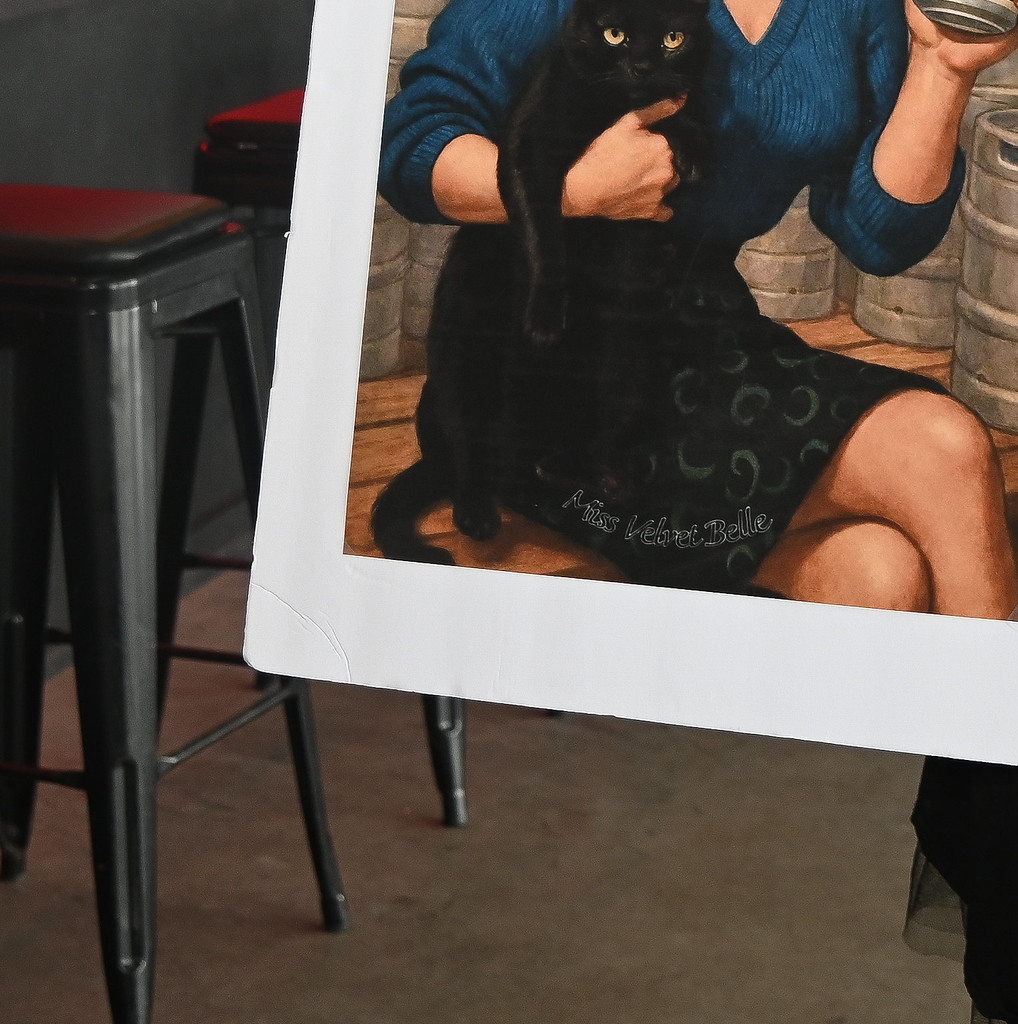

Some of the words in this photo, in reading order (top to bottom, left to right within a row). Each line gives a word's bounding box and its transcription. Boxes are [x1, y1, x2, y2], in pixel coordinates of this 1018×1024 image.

[562, 489, 620, 533] Miss
[624, 515, 704, 549] Velvet
[704, 506, 774, 547] Belle
